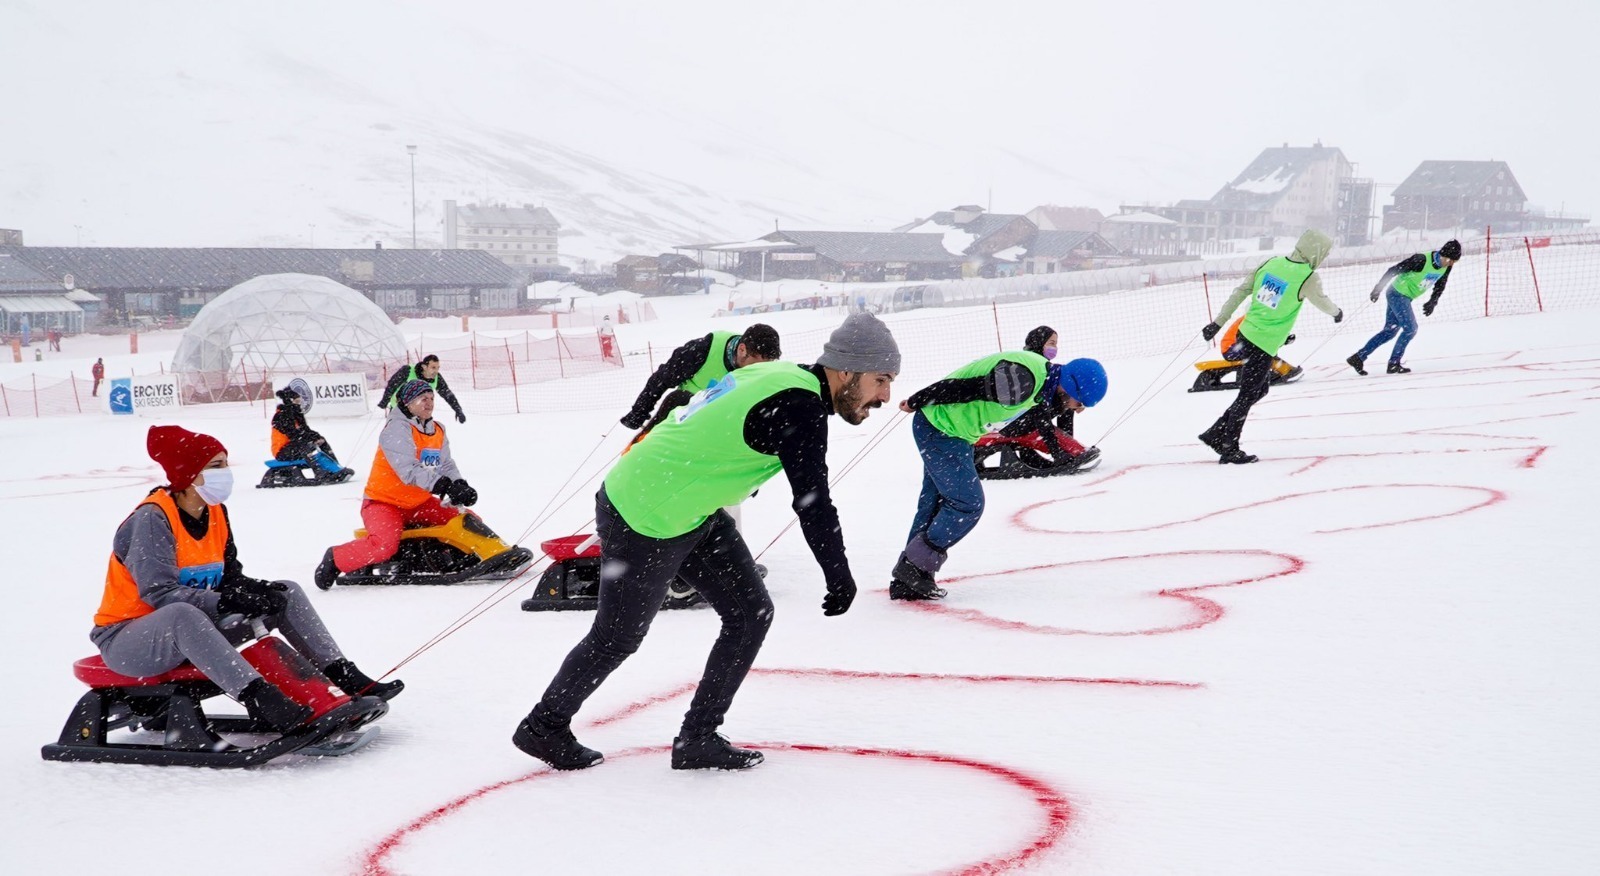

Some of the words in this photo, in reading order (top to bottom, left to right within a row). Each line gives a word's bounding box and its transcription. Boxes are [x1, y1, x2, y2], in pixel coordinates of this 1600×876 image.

[134, 397, 146, 408] SKI
[147, 396, 174, 407] RESORT
[424, 455, 441, 467] 028
